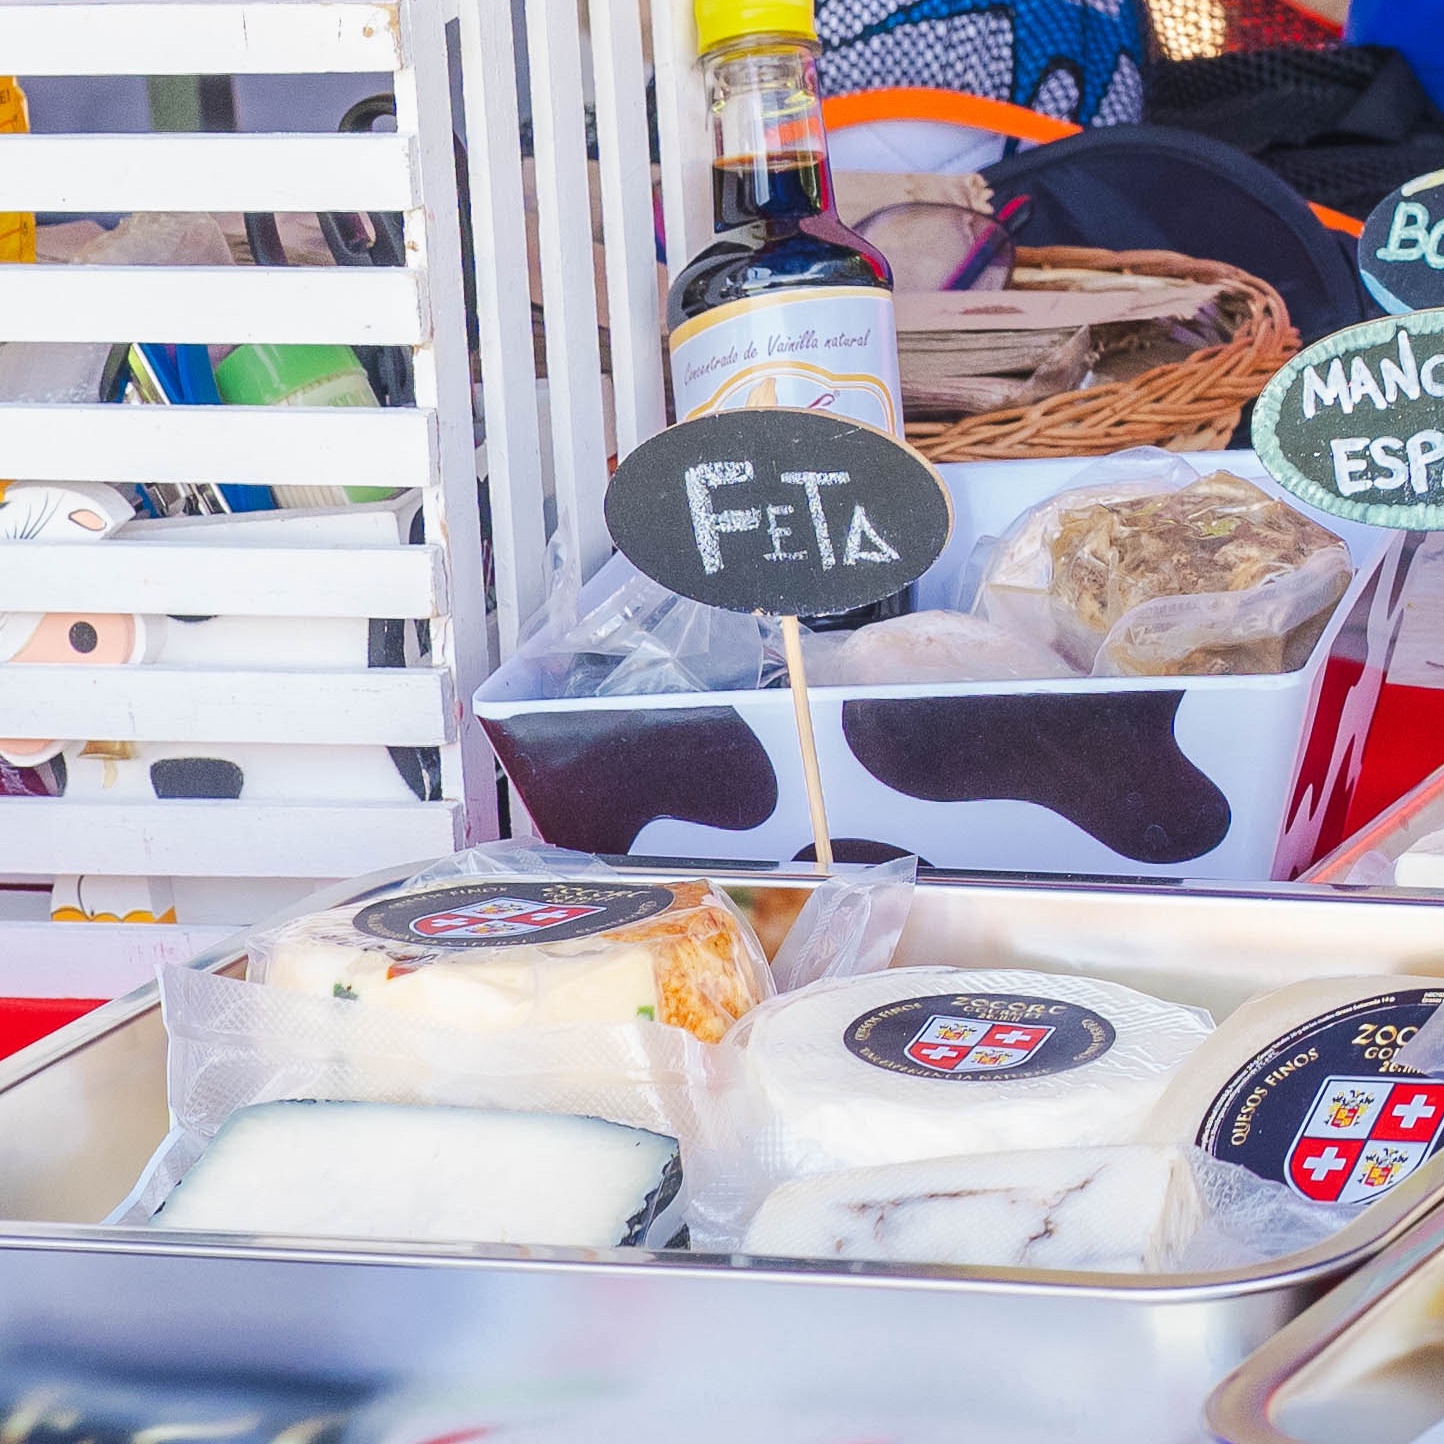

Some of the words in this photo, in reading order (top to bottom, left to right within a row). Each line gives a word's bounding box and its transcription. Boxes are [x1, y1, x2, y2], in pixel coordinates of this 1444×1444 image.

[744, 341, 759, 360] de
[767, 329, 819, 357] Vainilla
[823, 329, 872, 349] natural
[683, 460, 904, 576] FETA
[1231, 1086, 1268, 1146] QUESOS
[1264, 1047, 1320, 1087] FINOS
